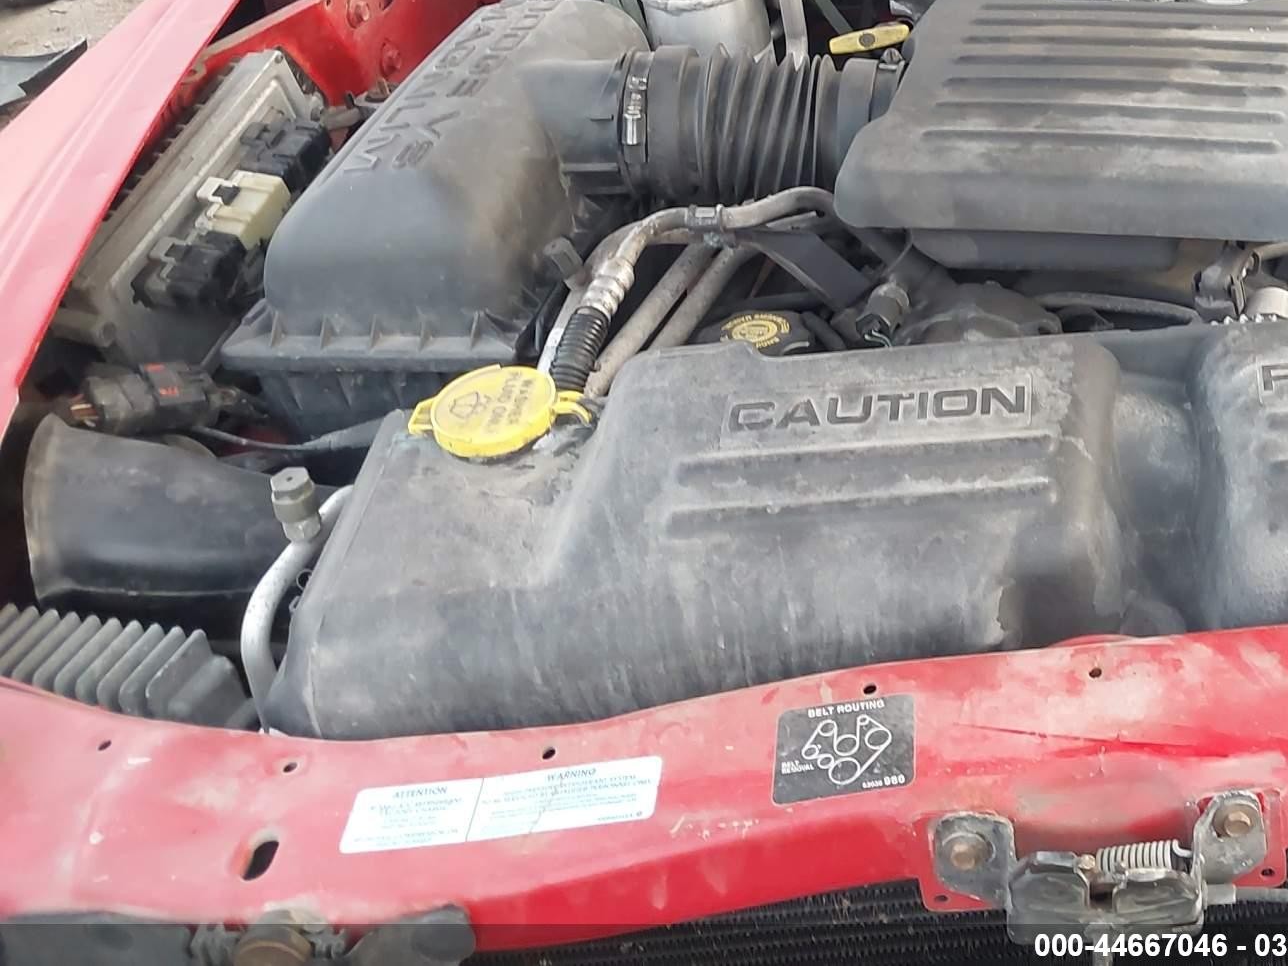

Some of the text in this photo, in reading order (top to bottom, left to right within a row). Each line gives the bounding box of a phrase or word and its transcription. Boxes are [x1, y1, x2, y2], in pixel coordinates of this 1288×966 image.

[729, 385, 1027, 431] CAUTION
[808, 699, 885, 719] BELT ROUTING
[547, 767, 597, 782] WARNING
[392, 785, 448, 799] ATTENTION
